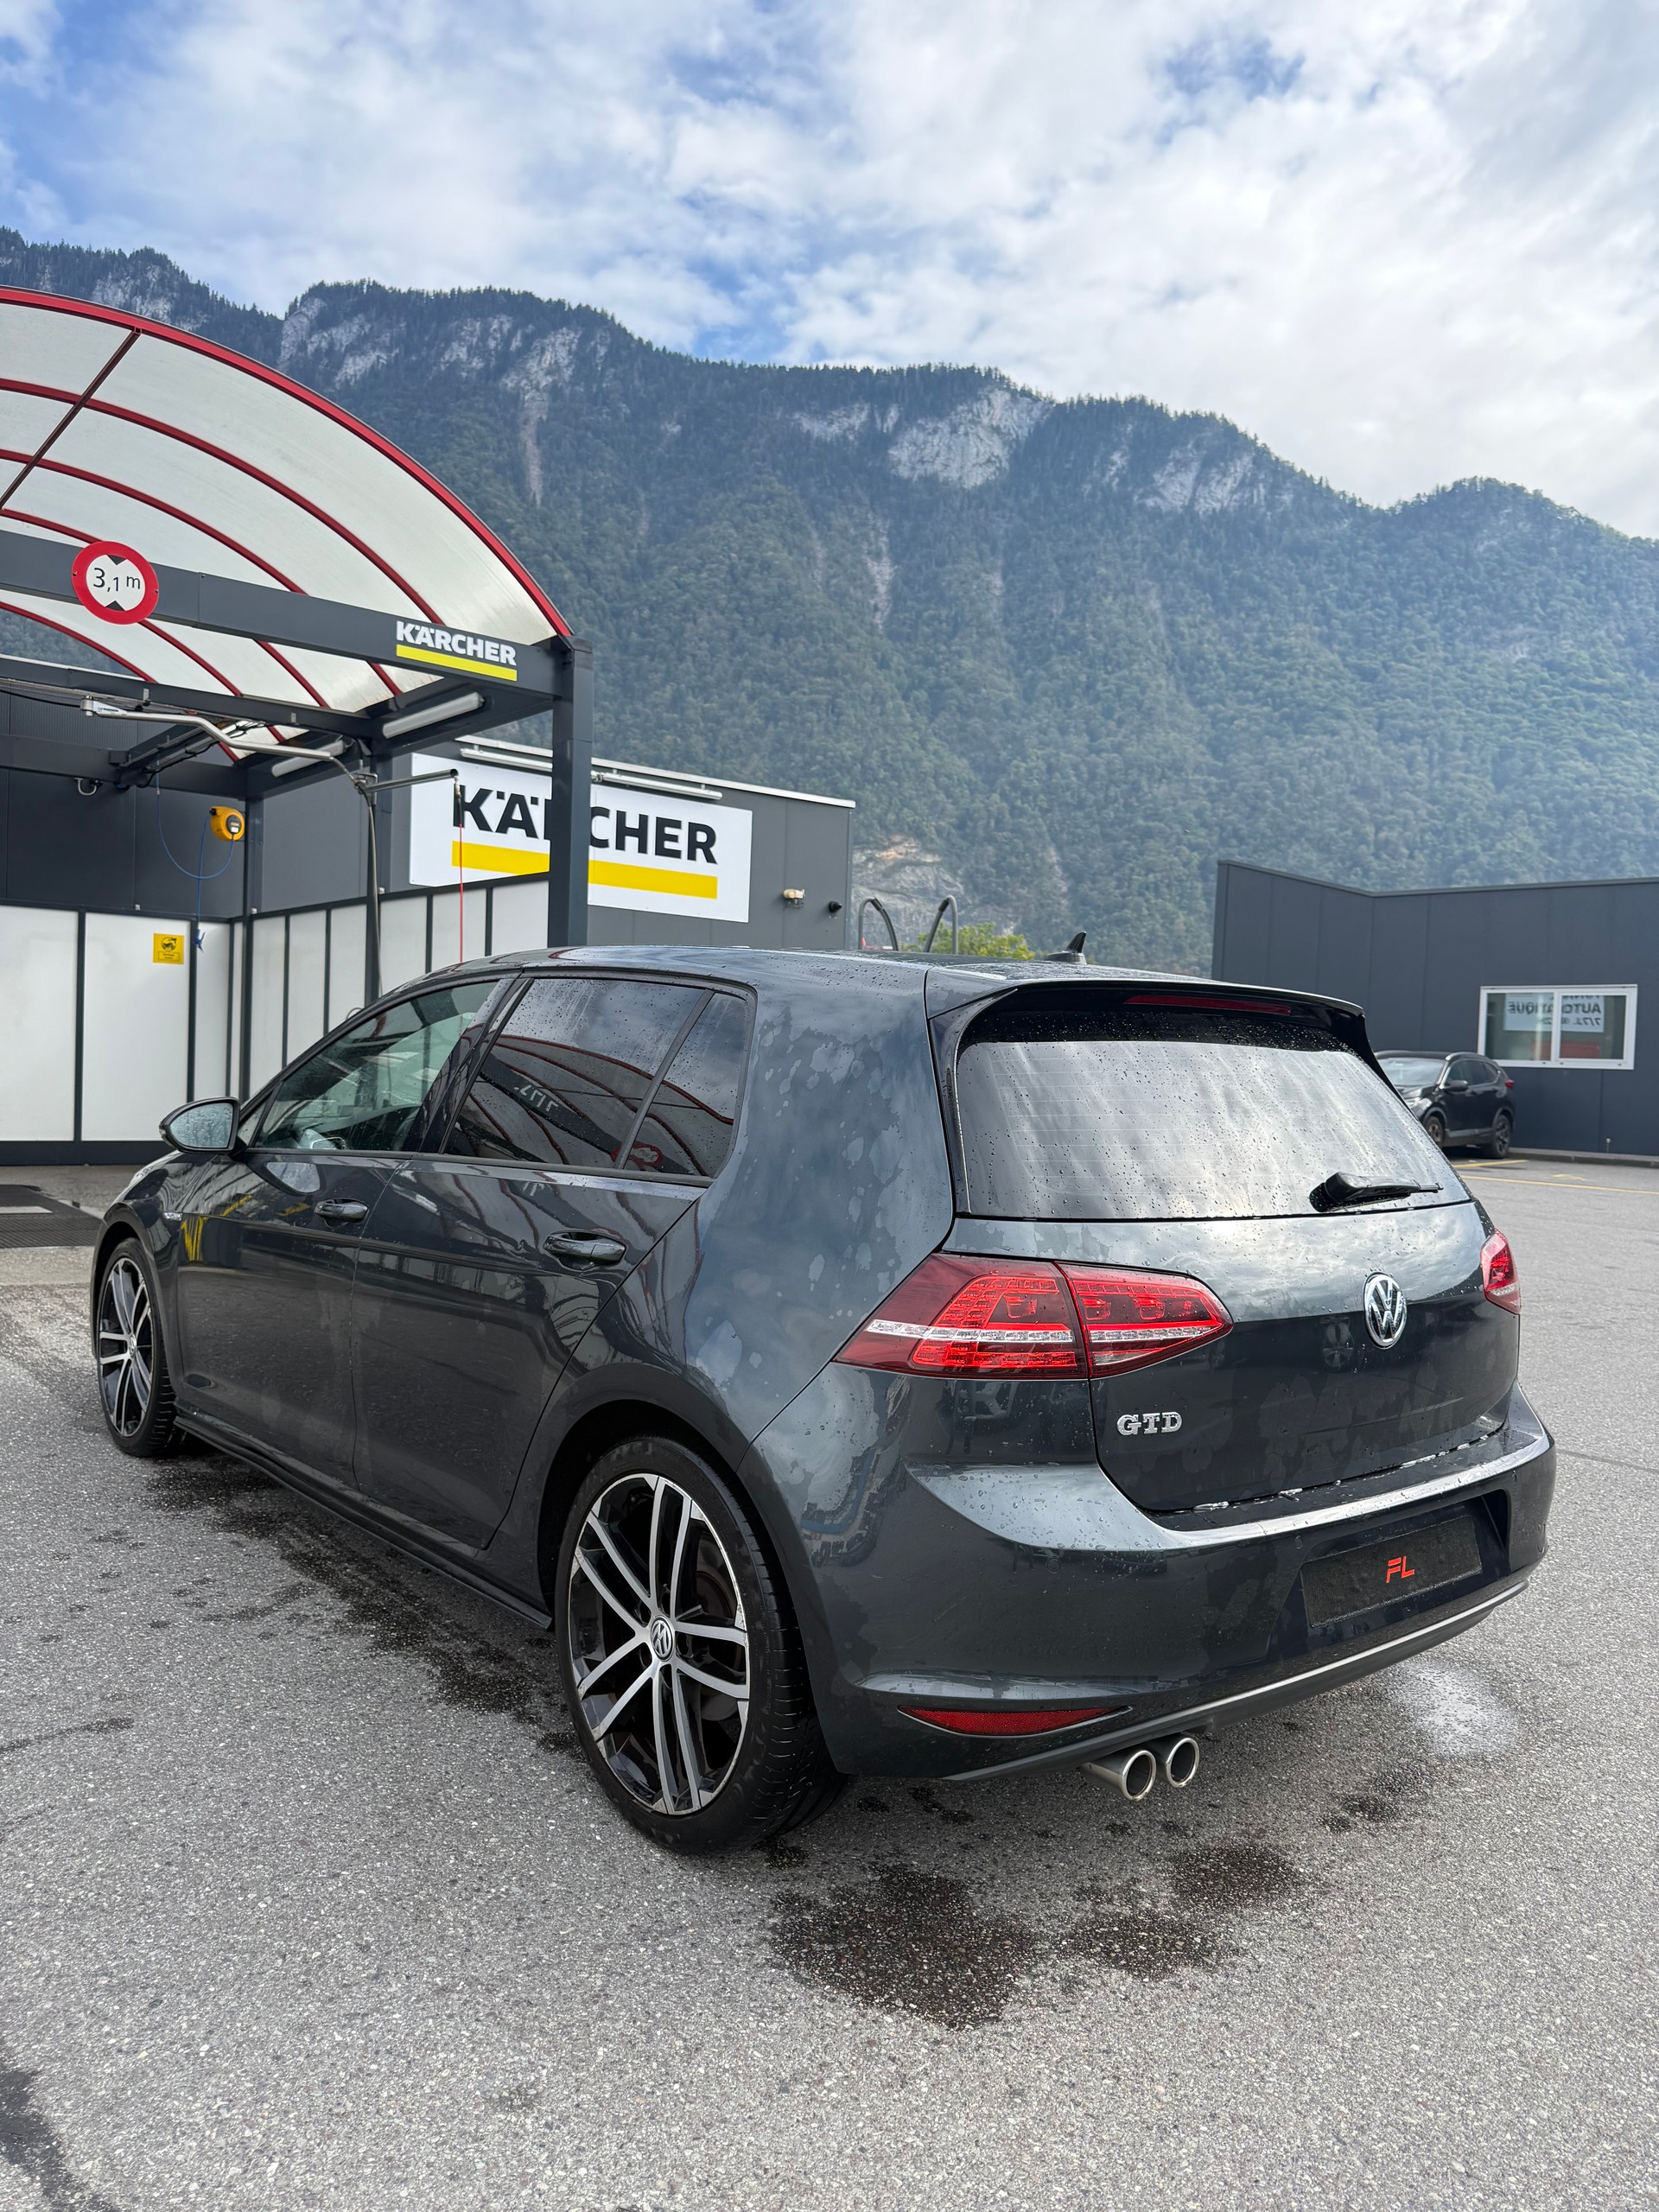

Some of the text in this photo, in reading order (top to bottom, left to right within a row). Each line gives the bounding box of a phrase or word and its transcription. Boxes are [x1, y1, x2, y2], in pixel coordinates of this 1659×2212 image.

[93, 567, 141, 593] 3,1 m
[396, 620, 518, 666] KÄRCHER
[453, 784, 718, 865] KÄCHER
[1364, 1273, 1407, 1349] VW
[1117, 1411, 1182, 1436] GTD
[1386, 1555, 1414, 1584] FL
